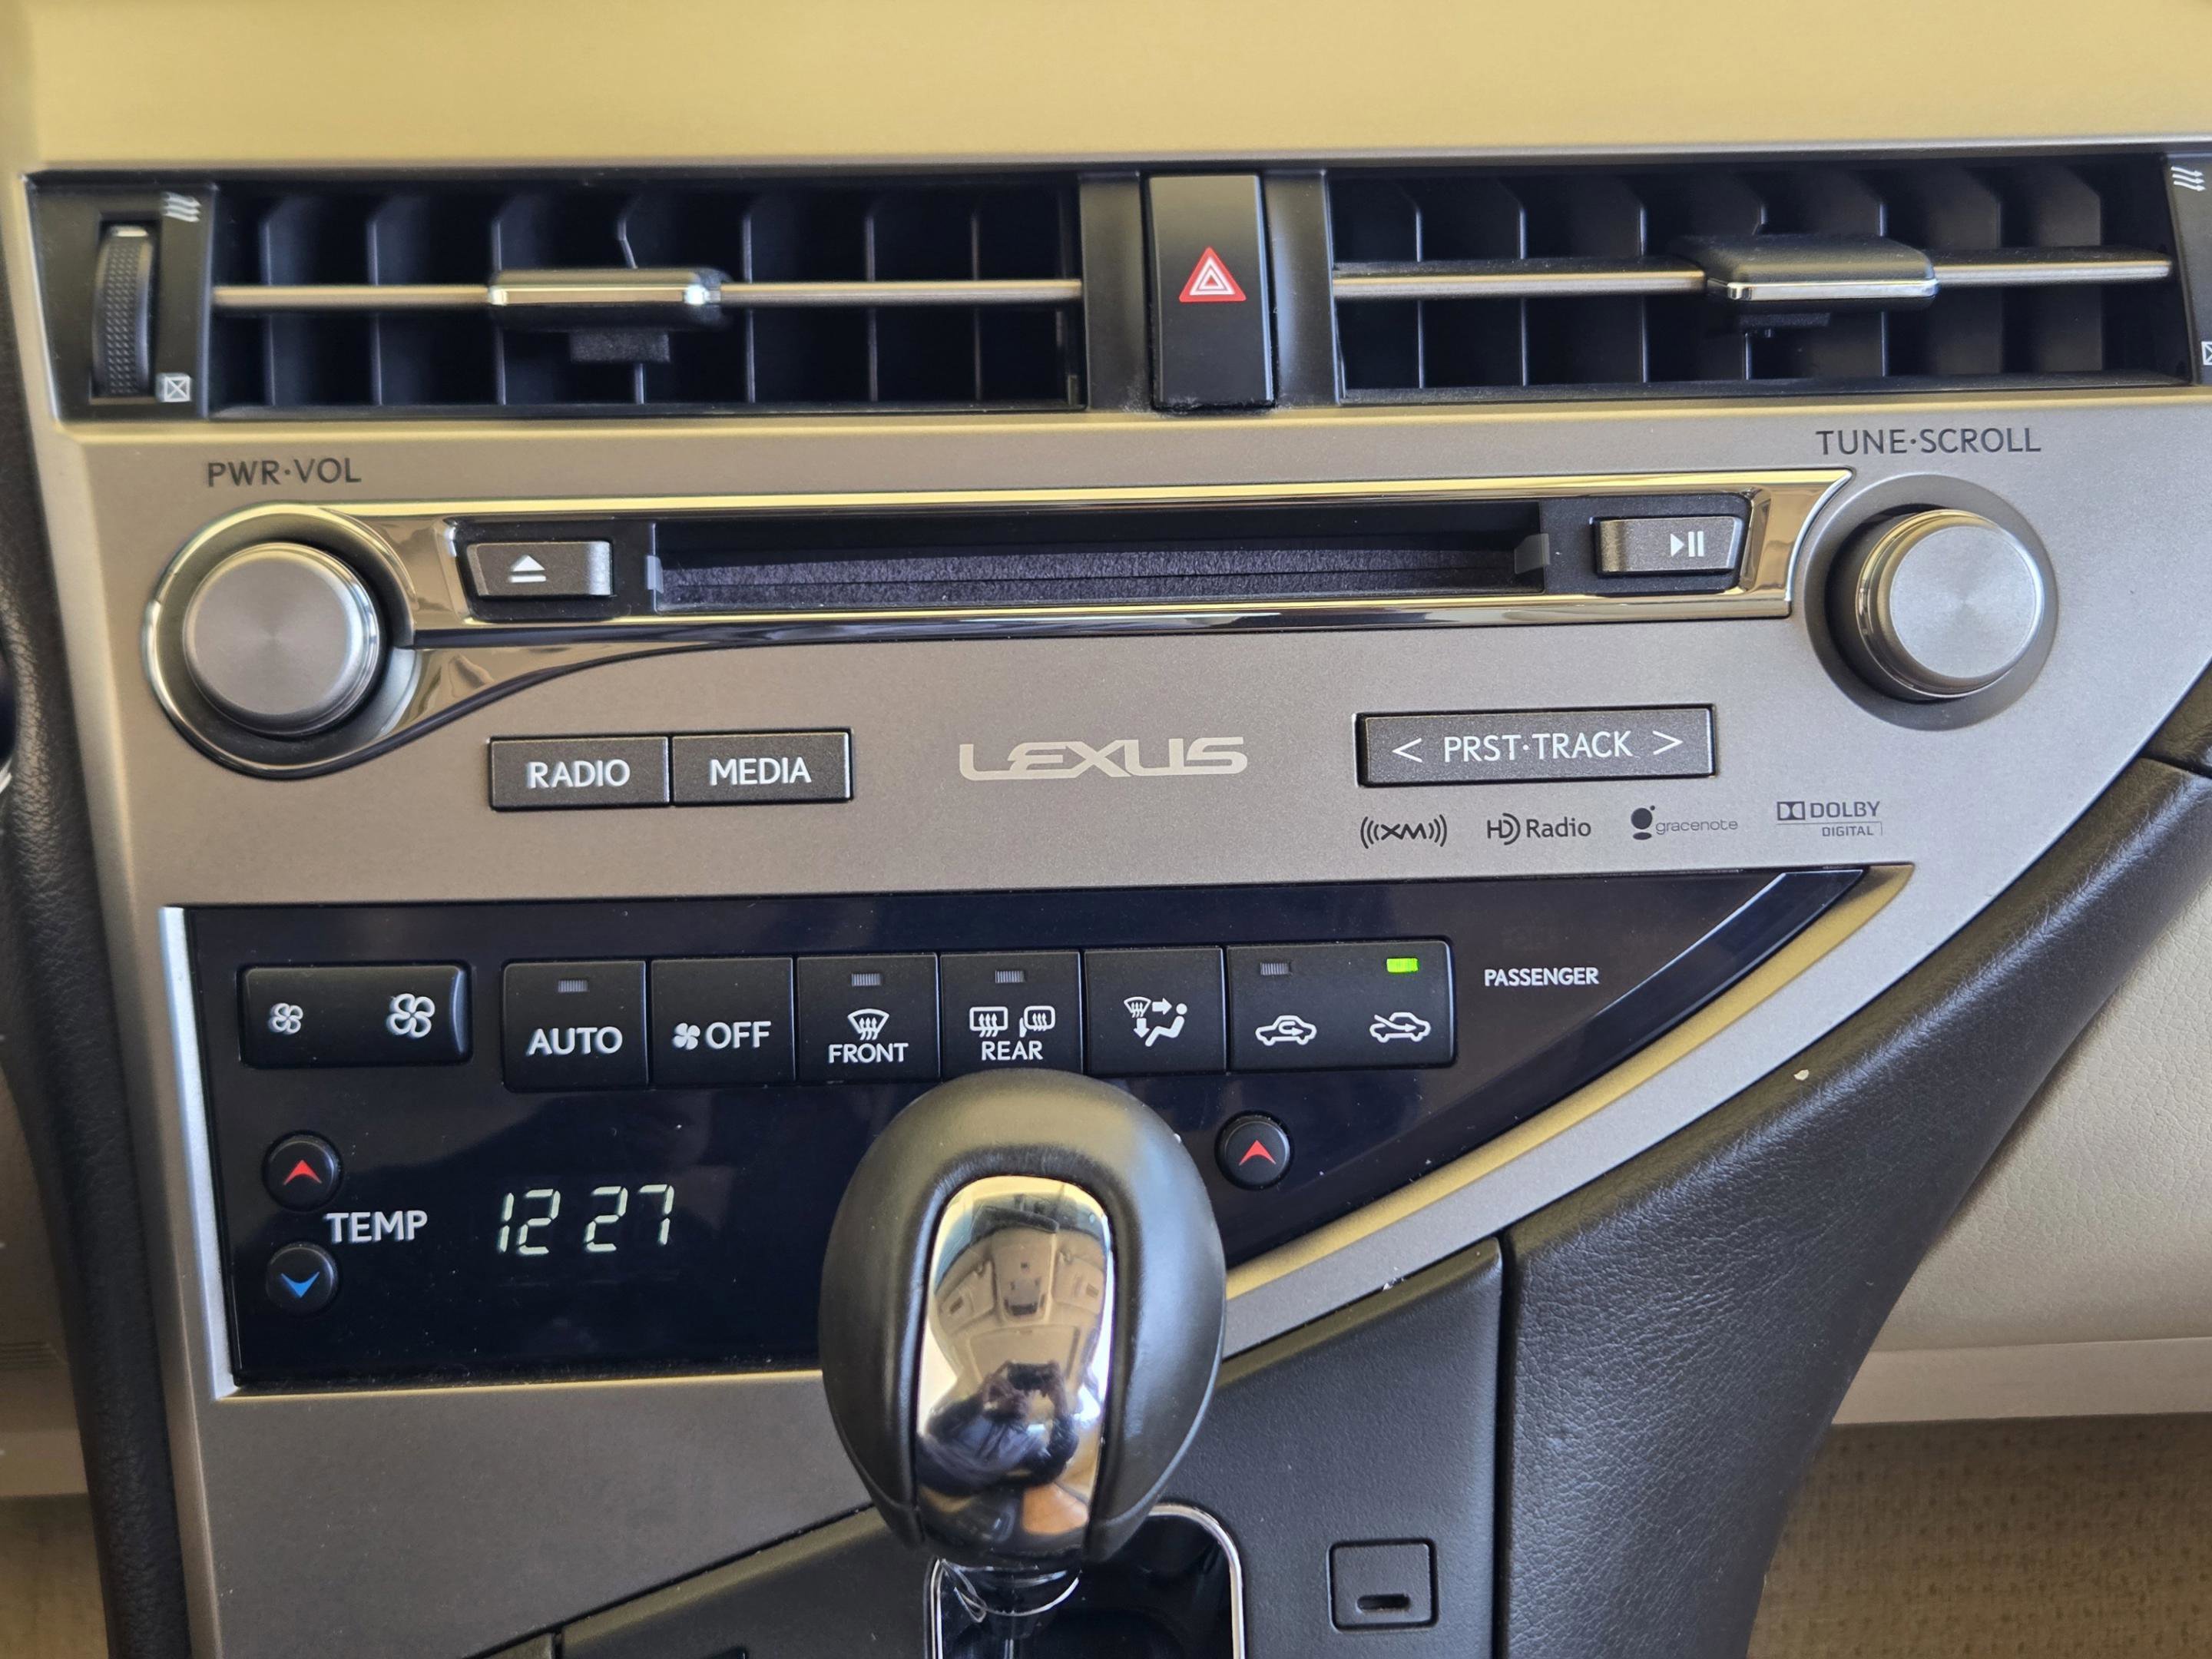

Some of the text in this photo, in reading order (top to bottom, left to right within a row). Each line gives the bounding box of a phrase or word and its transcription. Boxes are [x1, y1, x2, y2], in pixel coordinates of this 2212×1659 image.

[959, 737, 1248, 780] LEXUS
[526, 759, 630, 788] RADIO
[710, 757, 811, 786] MEDIA
[1810, 801, 1881, 818] DOLBY
[1526, 818, 1591, 839] Radio
[1655, 818, 1738, 835] gracenote
[1821, 826, 1875, 837] DIGITAL
[1484, 966, 1600, 988] PASSENGER
[527, 1026, 623, 1055] AUTO
[705, 1021, 771, 1049] OFF
[828, 1042, 909, 1065] FRONT
[982, 1040, 1043, 1061] REAR
[324, 1210, 428, 1244] TEMP
